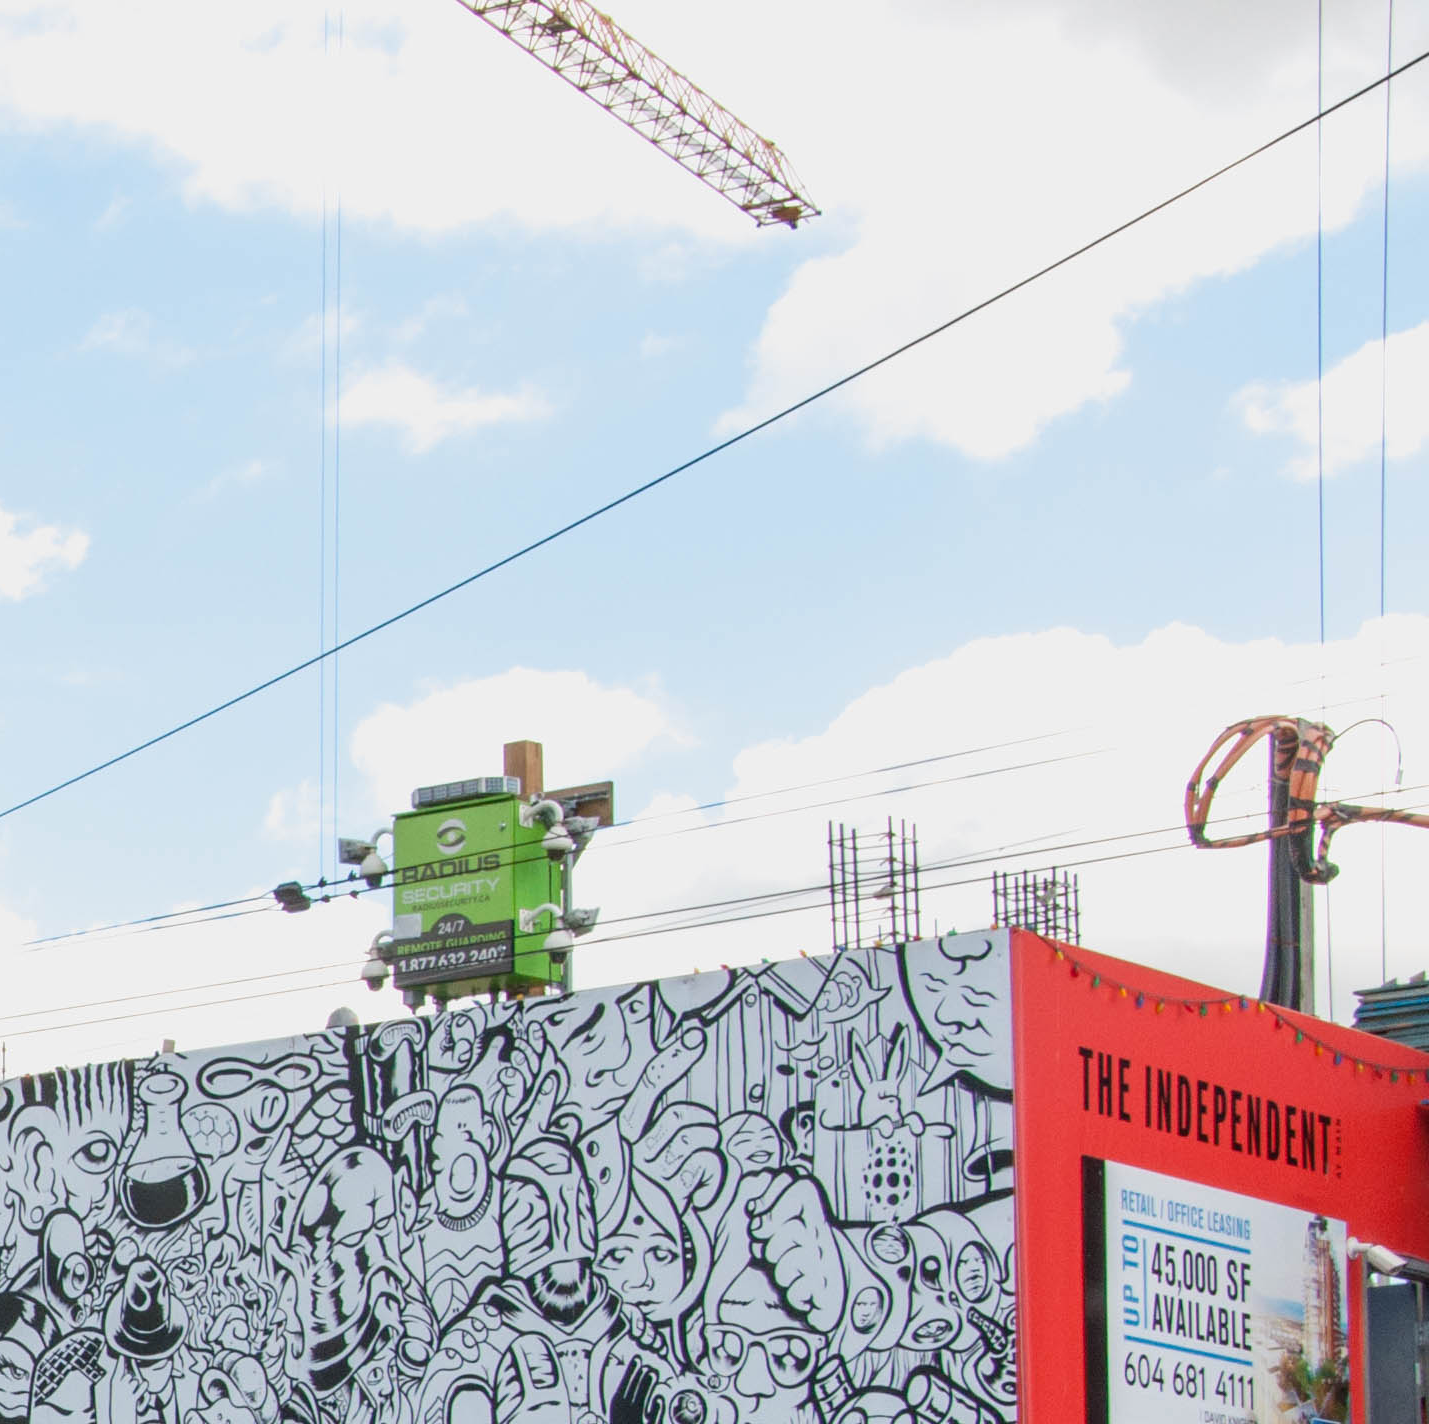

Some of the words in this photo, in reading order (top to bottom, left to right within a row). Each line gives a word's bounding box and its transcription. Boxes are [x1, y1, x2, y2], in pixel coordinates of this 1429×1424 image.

[402, 853, 500, 883] RADIUS
[402, 877, 500, 904] SECURITY
[397, 941, 442, 956] REMOTE
[445, 931, 507, 948] GUARDING
[438, 919, 465, 935] 24/7
[1078, 1046, 1132, 1123] THE
[1145, 1065, 1331, 1176] INDEPENDENT
[1121, 1189, 1157, 1218] RETAIL
[1167, 1200, 1204, 1229] OFFICE
[1207, 1211, 1251, 1240] LEASING
[1122, 1234, 1139, 1271] TO
[1151, 1243, 1218, 1295] 45,000
[1227, 1259, 1251, 1302] SF
[1123, 1284, 1140, 1327] UP
[1152, 1292, 1252, 1352] AVAILABLE
[1124, 1351, 1164, 1393] 604
[1173, 1361, 1206, 1400] 681
[1215, 1370, 1254, 1410] 4111
